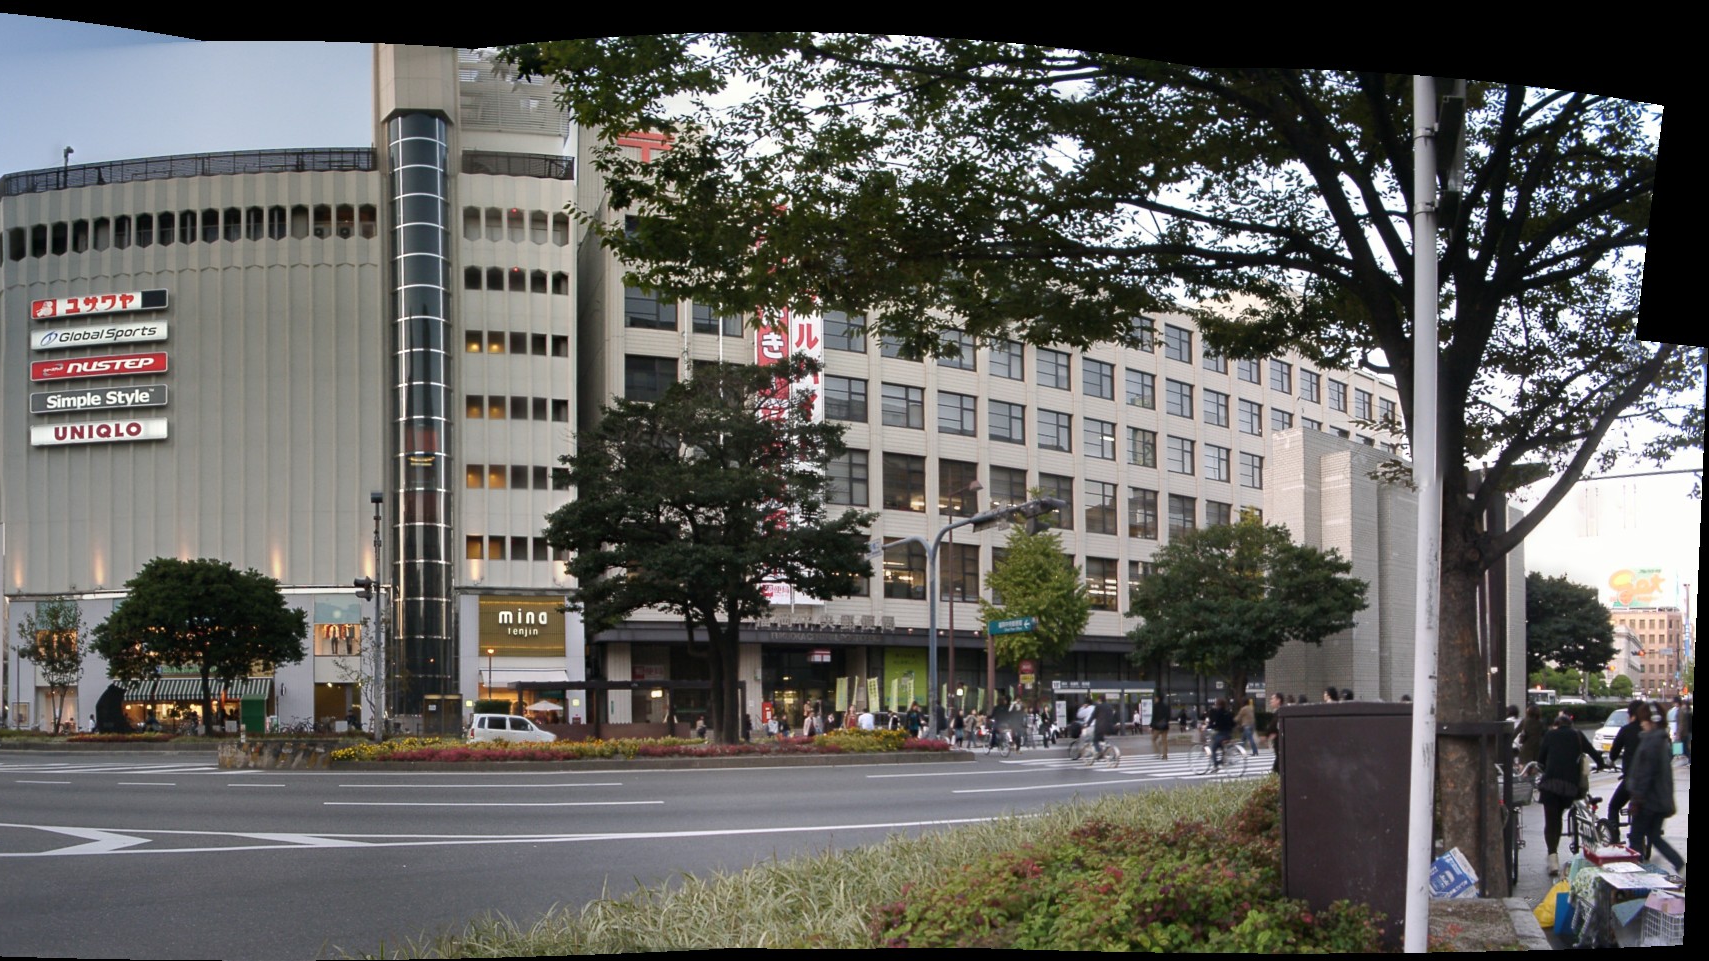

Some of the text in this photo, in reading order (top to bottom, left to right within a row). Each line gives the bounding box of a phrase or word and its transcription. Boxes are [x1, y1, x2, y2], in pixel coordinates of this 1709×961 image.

[59, 326, 157, 342] Global Sports
[46, 389, 150, 409] Simple Style
[54, 422, 142, 441] UNIQLO
[498, 608, 548, 625] mina
[507, 627, 538, 638] tenjin
